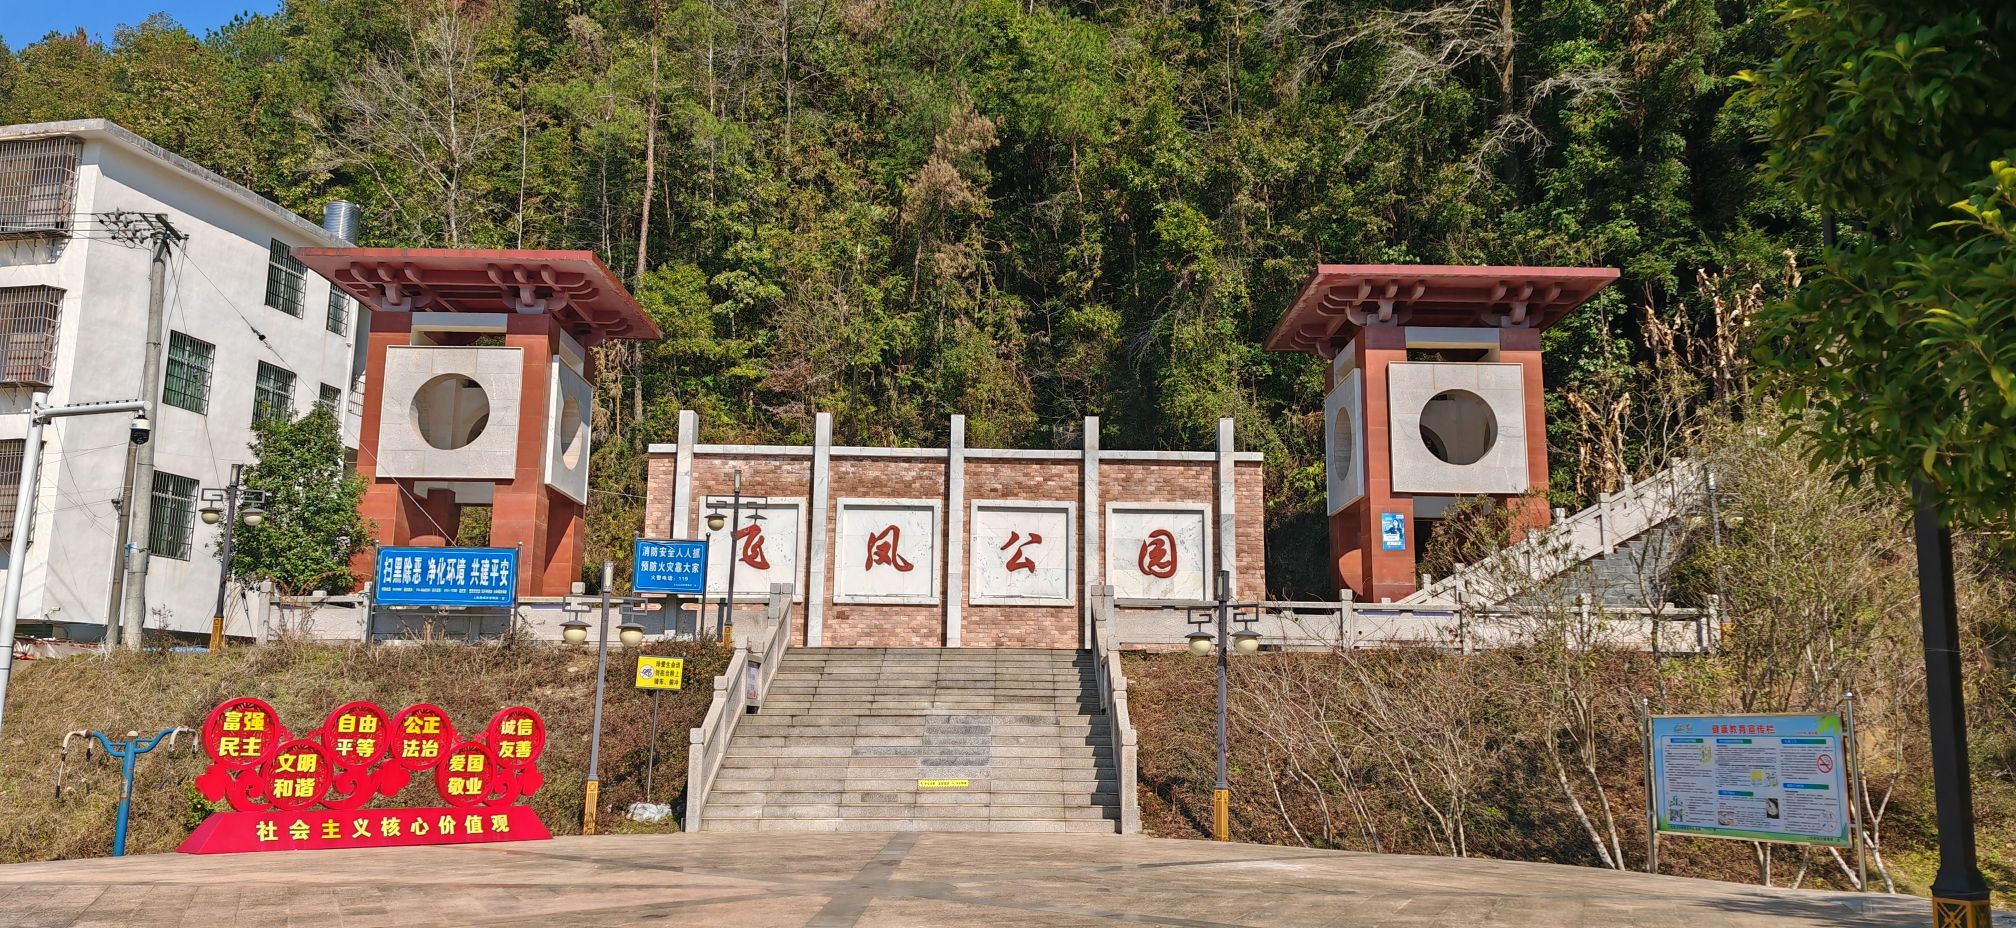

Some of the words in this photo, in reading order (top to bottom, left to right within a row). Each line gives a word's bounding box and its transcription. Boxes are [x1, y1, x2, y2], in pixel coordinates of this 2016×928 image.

[383, 556, 423, 585] 扫黑除恶
[427, 557, 467, 586] 净化环境
[470, 558, 510, 587] 共建平安
[640, 560, 700, 574] 预防火灾靠大家
[222, 710, 265, 732] 富强
[337, 713, 378, 734] 自由
[403, 716, 441, 736] 公正
[500, 718, 534, 736] 诚信
[218, 737, 263, 757] 民主
[335, 738, 376, 758] 平等
[401, 739, 440, 758] 法治
[499, 739, 533, 759] 友善
[275, 753, 317, 774] 文明
[449, 754, 486, 773] 爱国
[273, 778, 316, 799] 和谐
[447, 776, 483, 796] 敬业
[255, 814, 511, 842] 社会主义核心价值观
